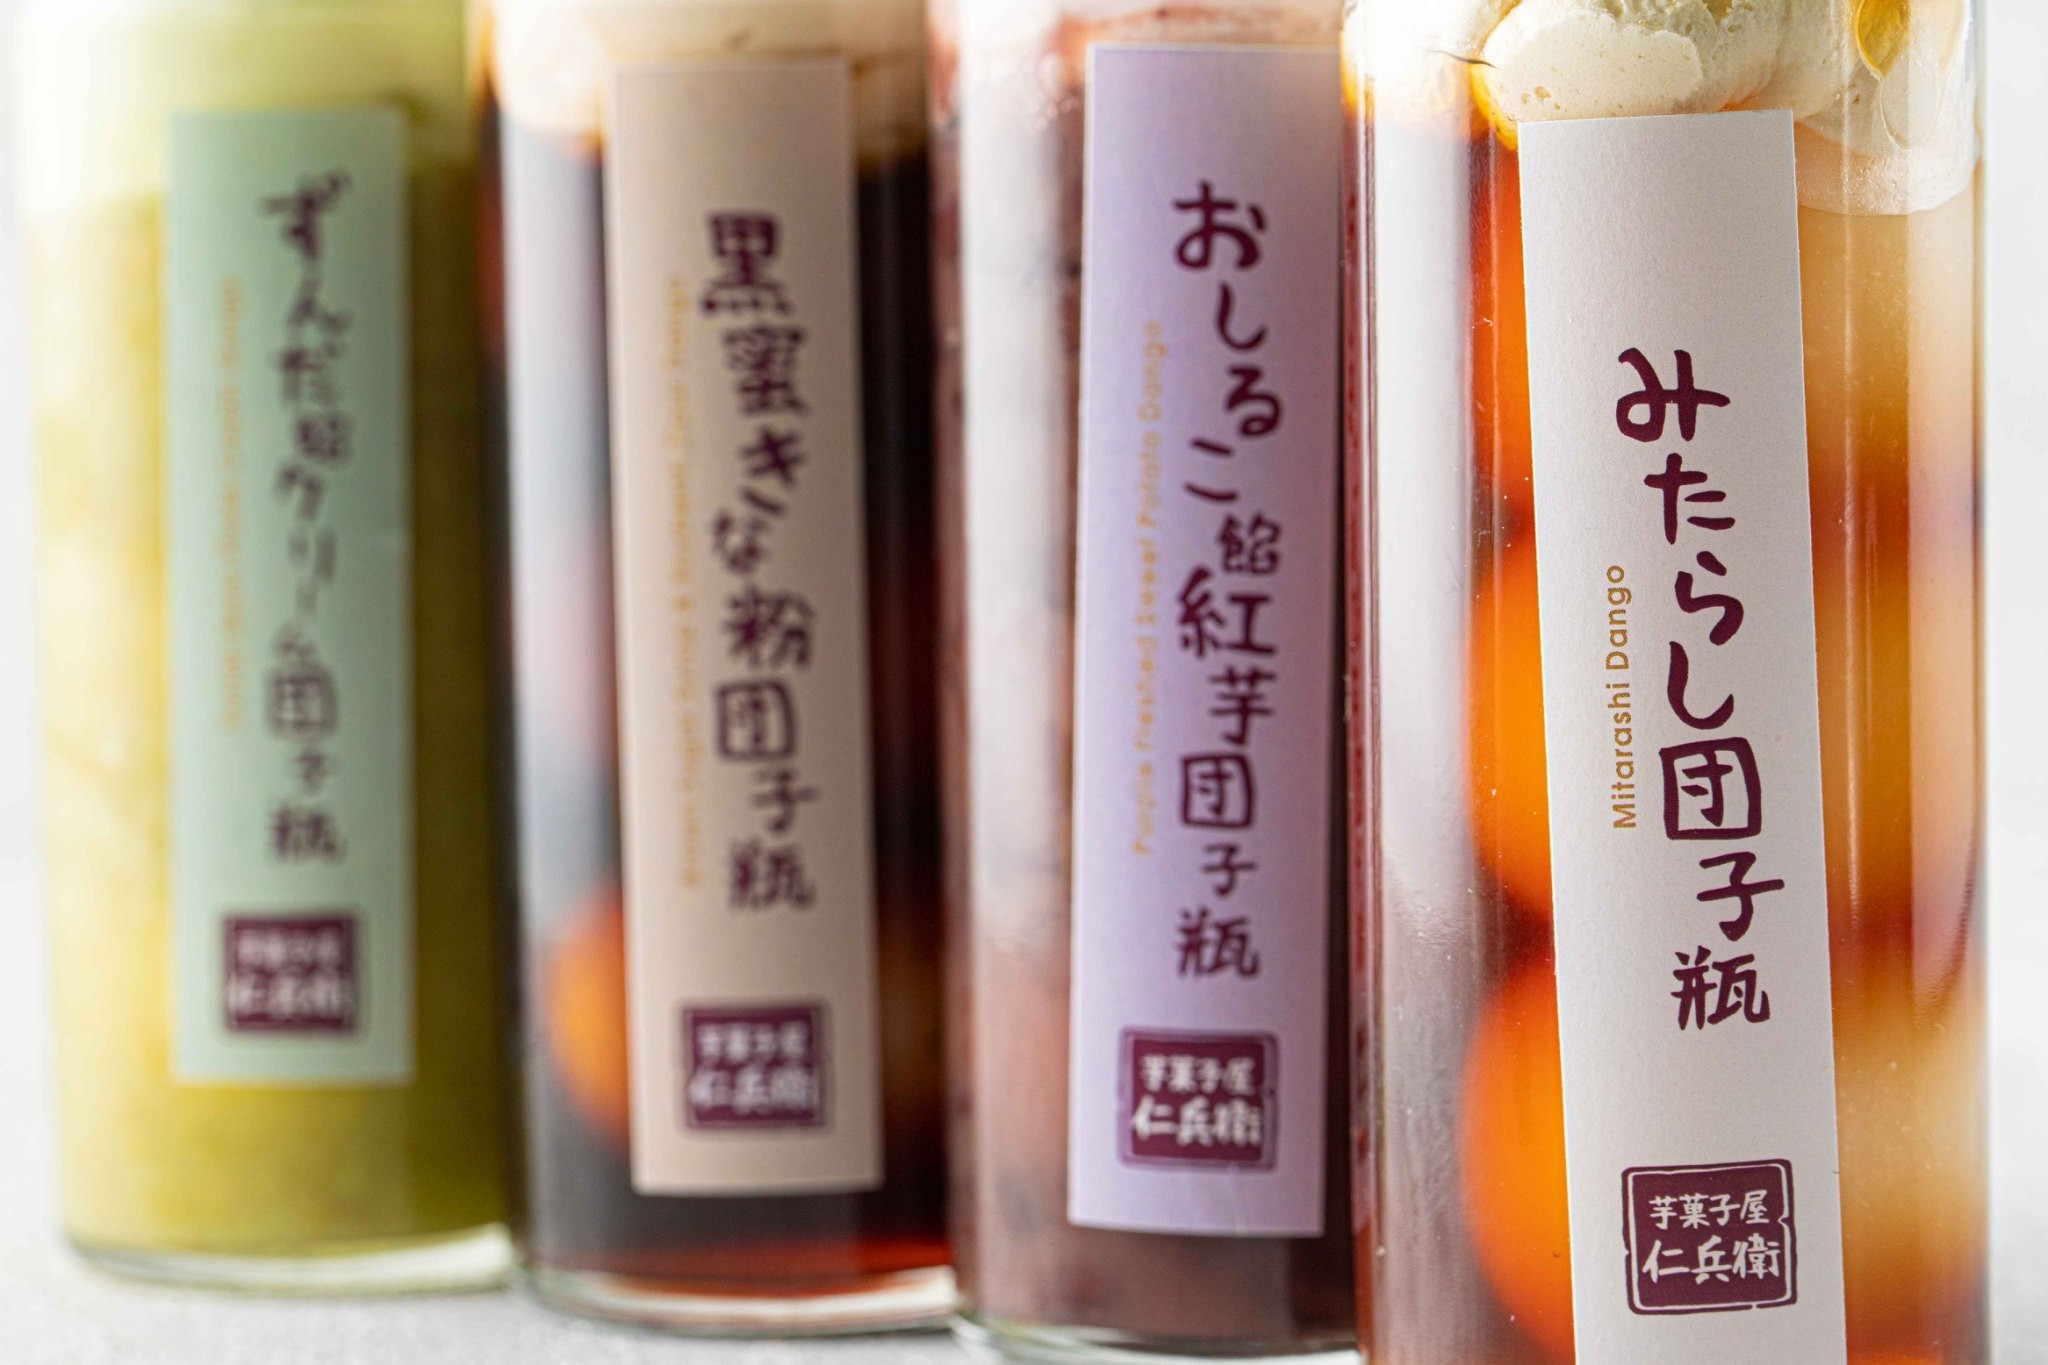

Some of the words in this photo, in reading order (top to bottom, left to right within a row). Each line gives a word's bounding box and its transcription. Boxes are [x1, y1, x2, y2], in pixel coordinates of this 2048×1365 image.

[1138, 319, 1169, 423] Dango
[1137, 429, 1163, 528] Potato
[1134, 539, 1160, 627] Sweet
[1172, 180, 1283, 979] おしるこ餡紅芋団子瓶
[1605, 564, 1633, 671] Dango
[1615, 346, 1785, 1031] みたらし団子瓶
[1606, 682, 1637, 830] Mitarashi
[1131, 1094, 1263, 1148] 仁兵衛
[1641, 1233, 1781, 1285] 仁兵衛
[1648, 1189, 1769, 1231] 芋菓子屋
